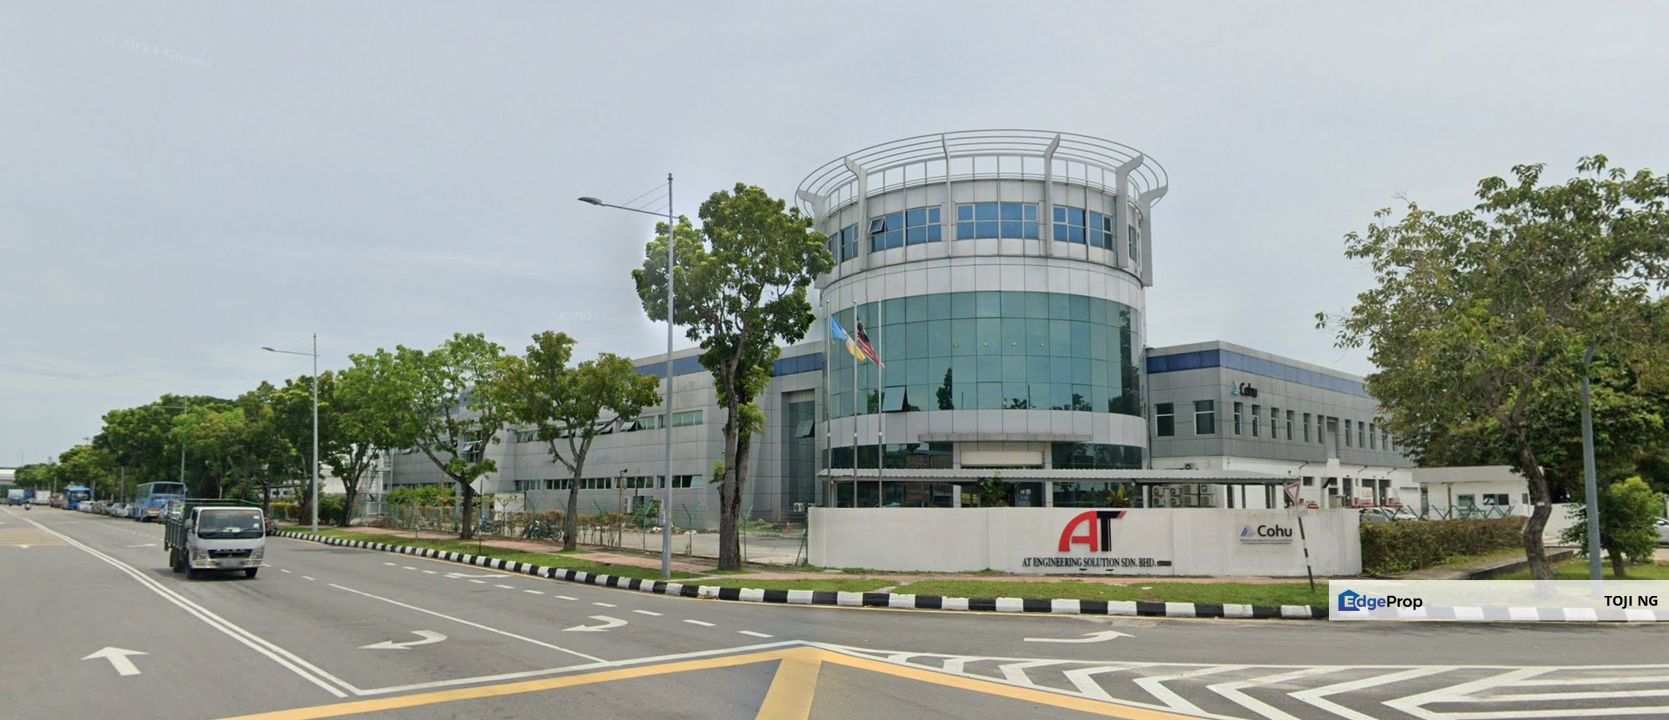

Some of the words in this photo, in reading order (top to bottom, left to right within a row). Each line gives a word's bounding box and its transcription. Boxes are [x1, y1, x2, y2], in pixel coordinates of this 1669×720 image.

[1240, 382, 1257, 398] Cohu
[1058, 510, 1127, 552] AT
[1257, 524, 1293, 537] Cohu
[1022, 557, 1032, 567] AT
[1033, 557, 1082, 567] ENGINEERING
[1083, 557, 1120, 567] SOLUTION
[1121, 557, 1138, 567] SDN.
[1139, 557, 1157, 567] BHD.
